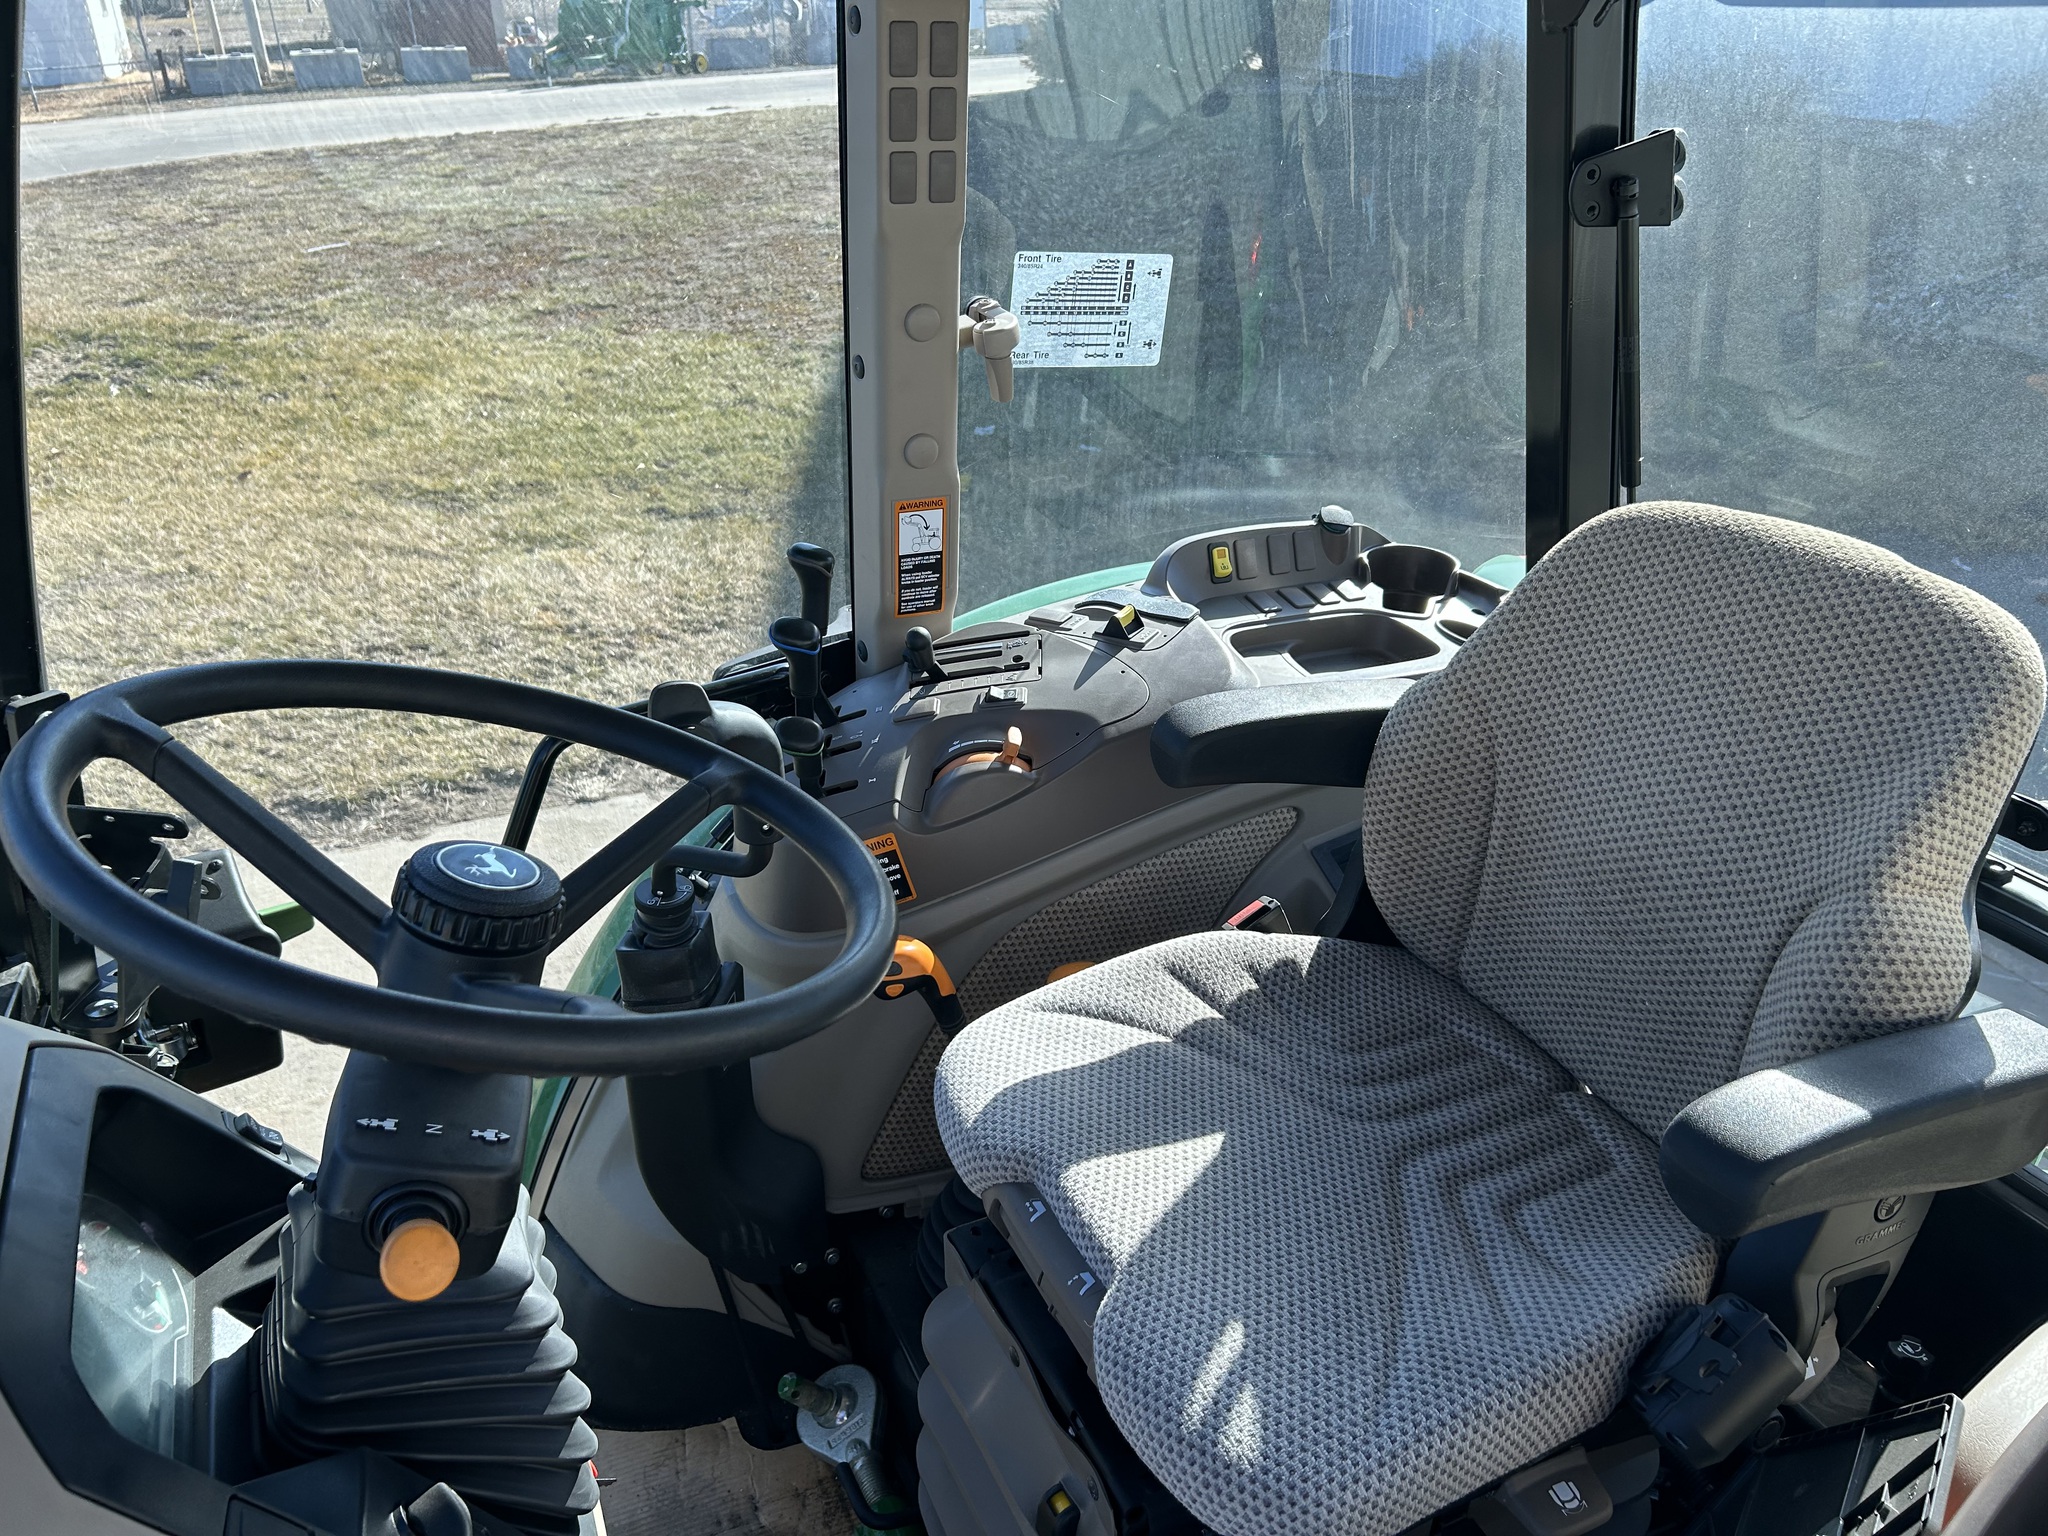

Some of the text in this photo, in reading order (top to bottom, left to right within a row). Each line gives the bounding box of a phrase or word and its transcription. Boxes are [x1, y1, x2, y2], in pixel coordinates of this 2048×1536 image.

[1018, 253, 1062, 263] Front Tire
[1033, 351, 1050, 359] Tire
[906, 499, 943, 509] WARNING
[866, 837, 894, 851] NING
